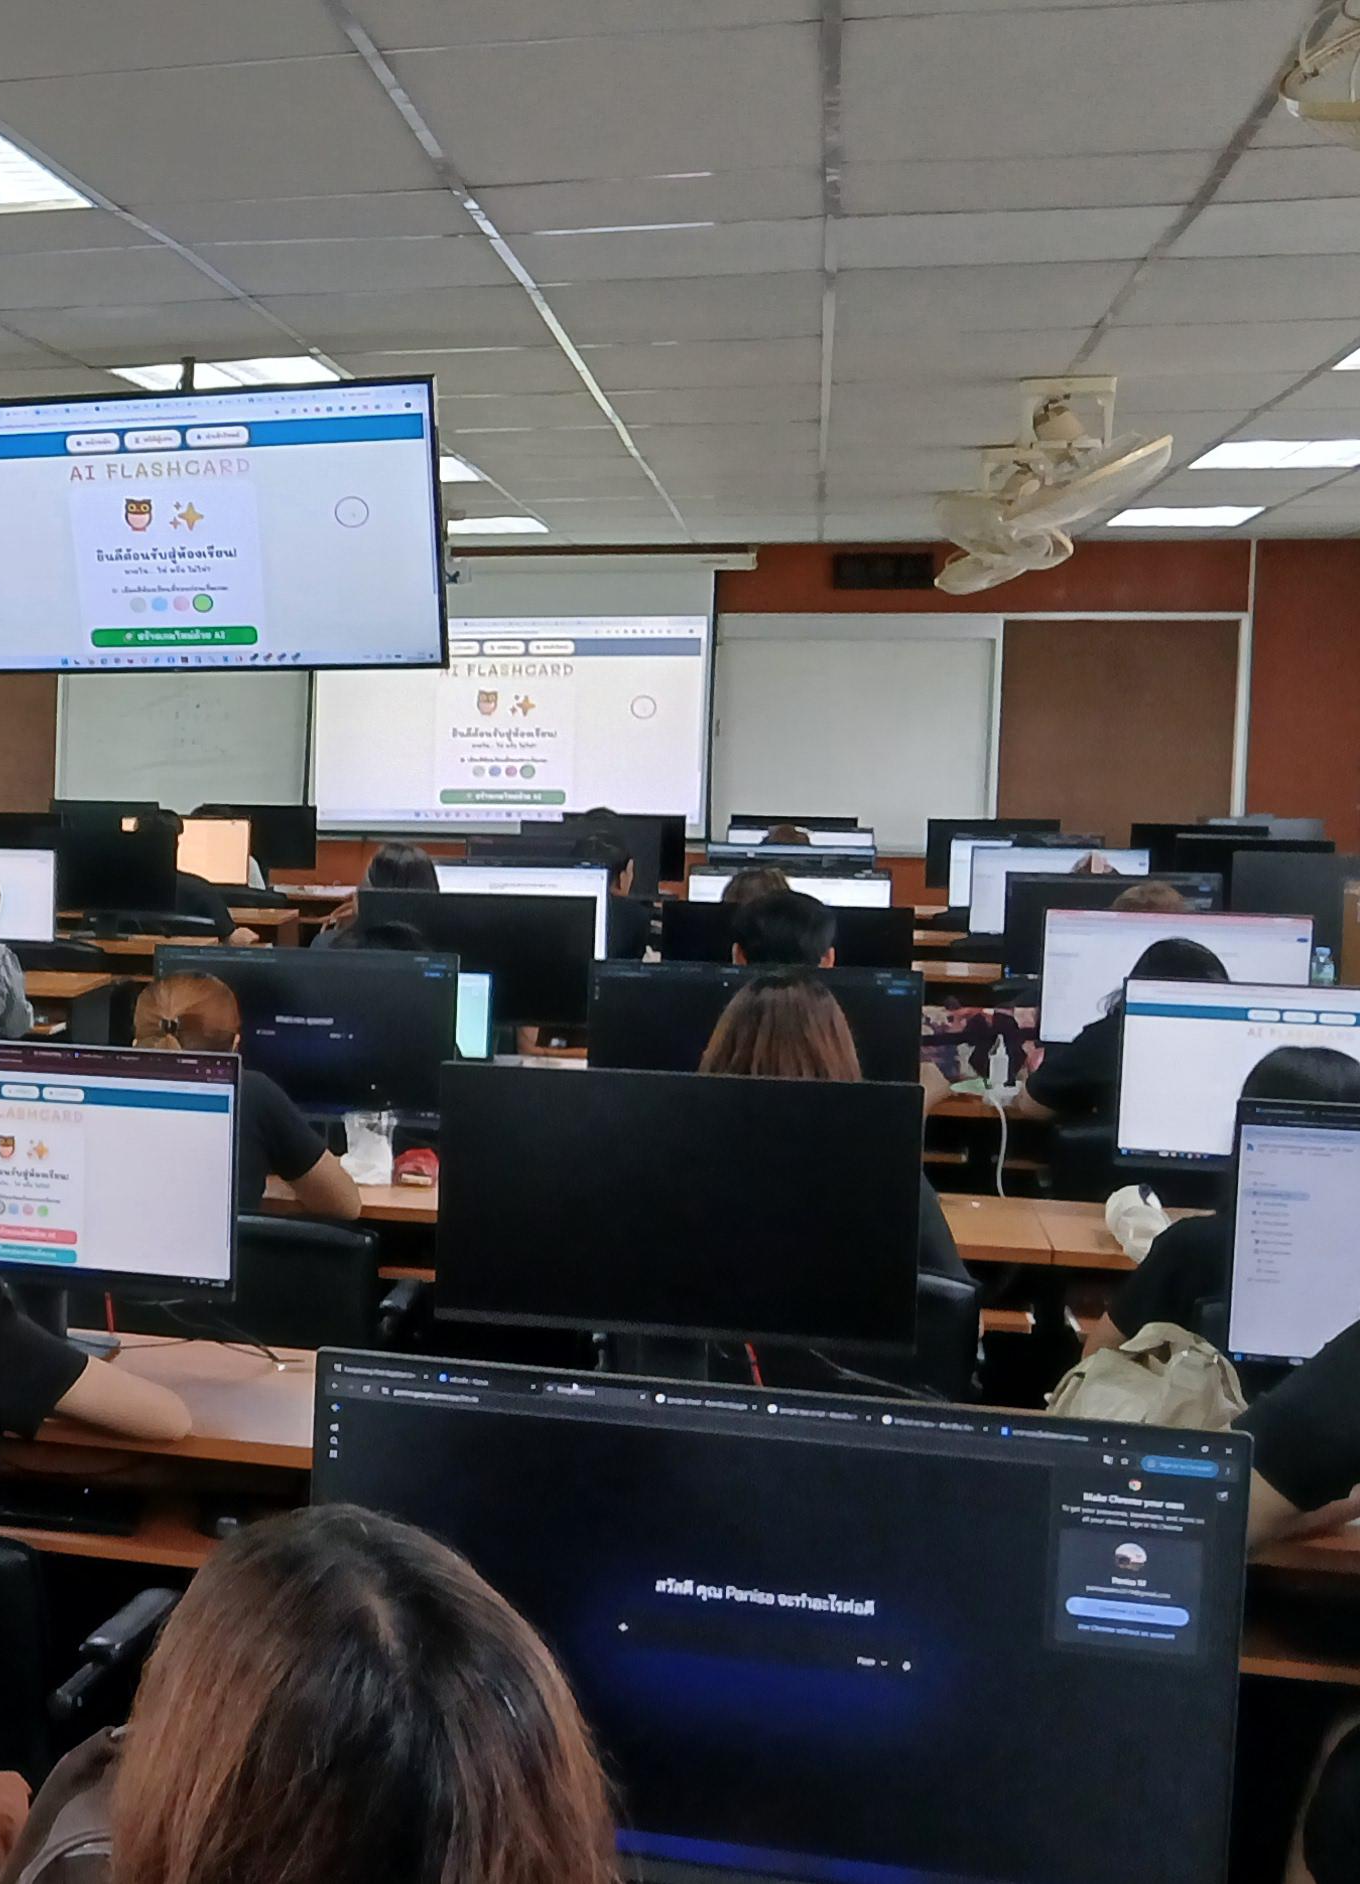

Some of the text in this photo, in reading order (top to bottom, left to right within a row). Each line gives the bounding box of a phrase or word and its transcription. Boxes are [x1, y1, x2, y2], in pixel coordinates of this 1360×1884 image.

[70, 458, 250, 481] AI FLASHCARD
[468, 663, 574, 677] FLASHCARD
